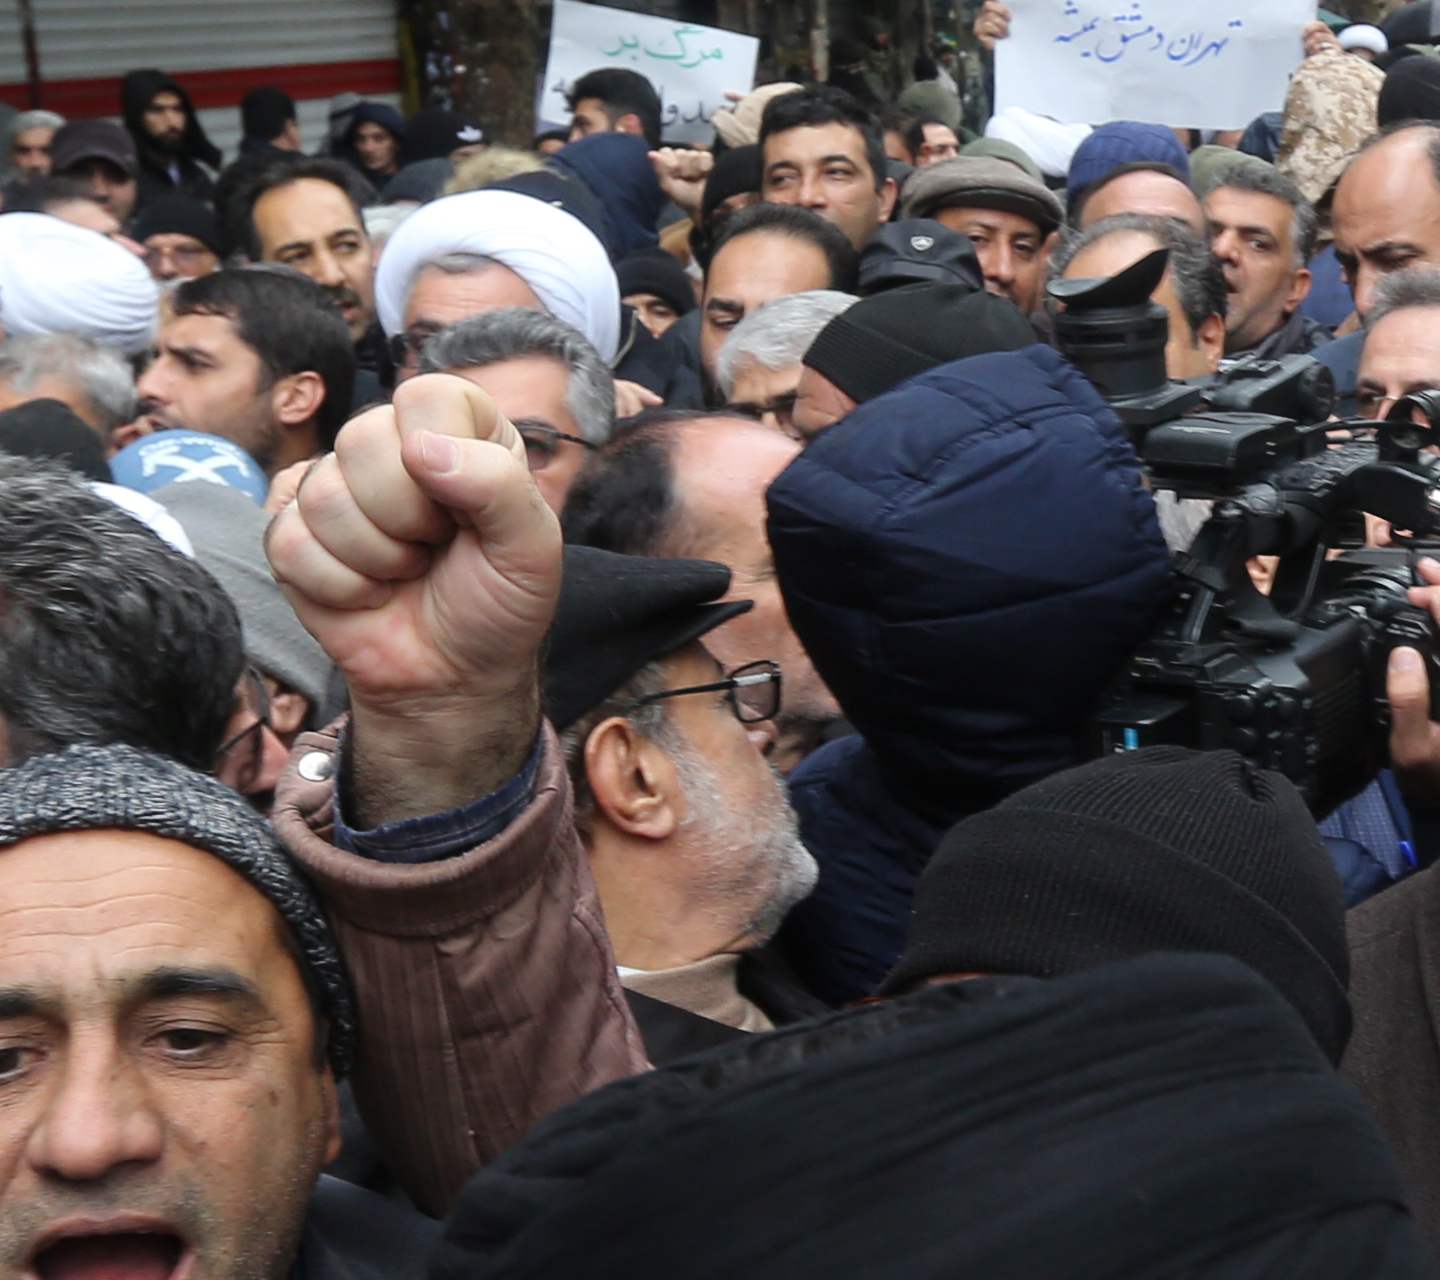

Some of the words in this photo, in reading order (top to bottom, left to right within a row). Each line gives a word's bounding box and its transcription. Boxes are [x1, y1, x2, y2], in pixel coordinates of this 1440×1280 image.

[599, 32, 640, 62] بر
[644, 25, 725, 69] مرگ
[1094, 2, 1165, 63] دمشق
[1165, 18, 1244, 67] تهران
